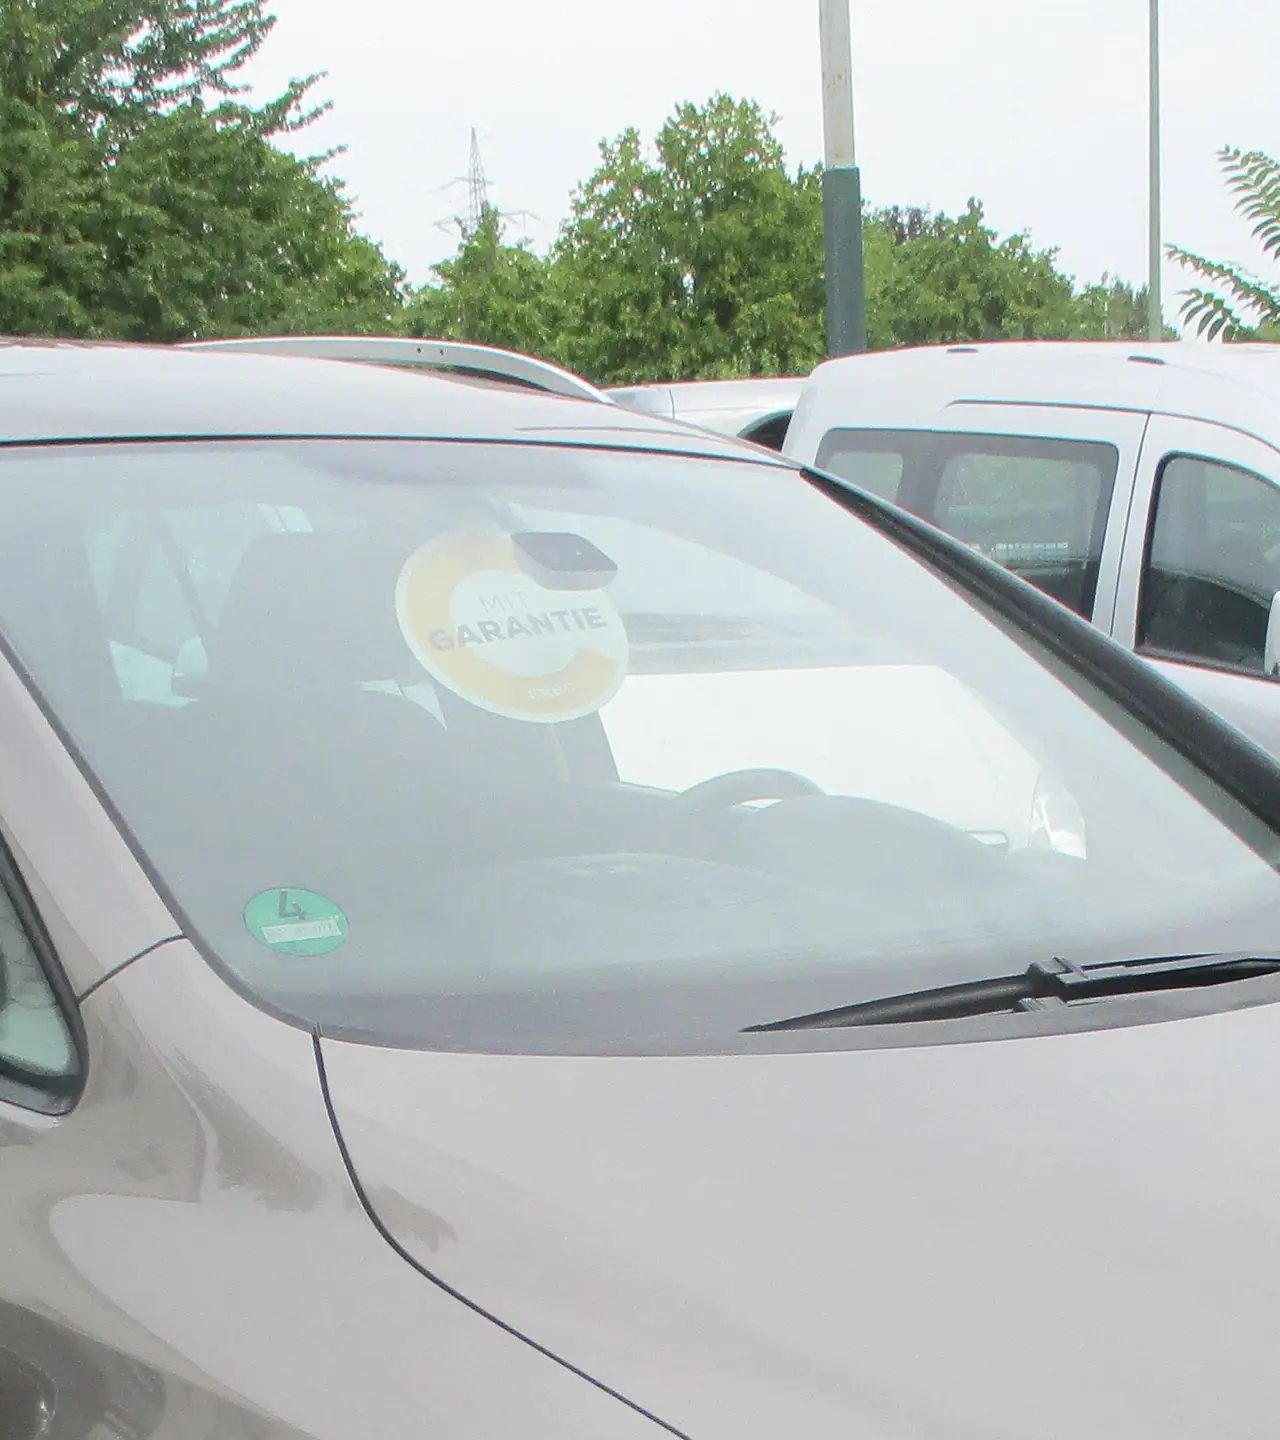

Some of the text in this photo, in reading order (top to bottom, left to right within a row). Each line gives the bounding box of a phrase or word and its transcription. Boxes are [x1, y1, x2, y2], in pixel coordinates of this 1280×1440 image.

[479, 591, 528, 613] MIT
[427, 607, 607, 651] GARANTIE
[278, 889, 307, 920] 4
